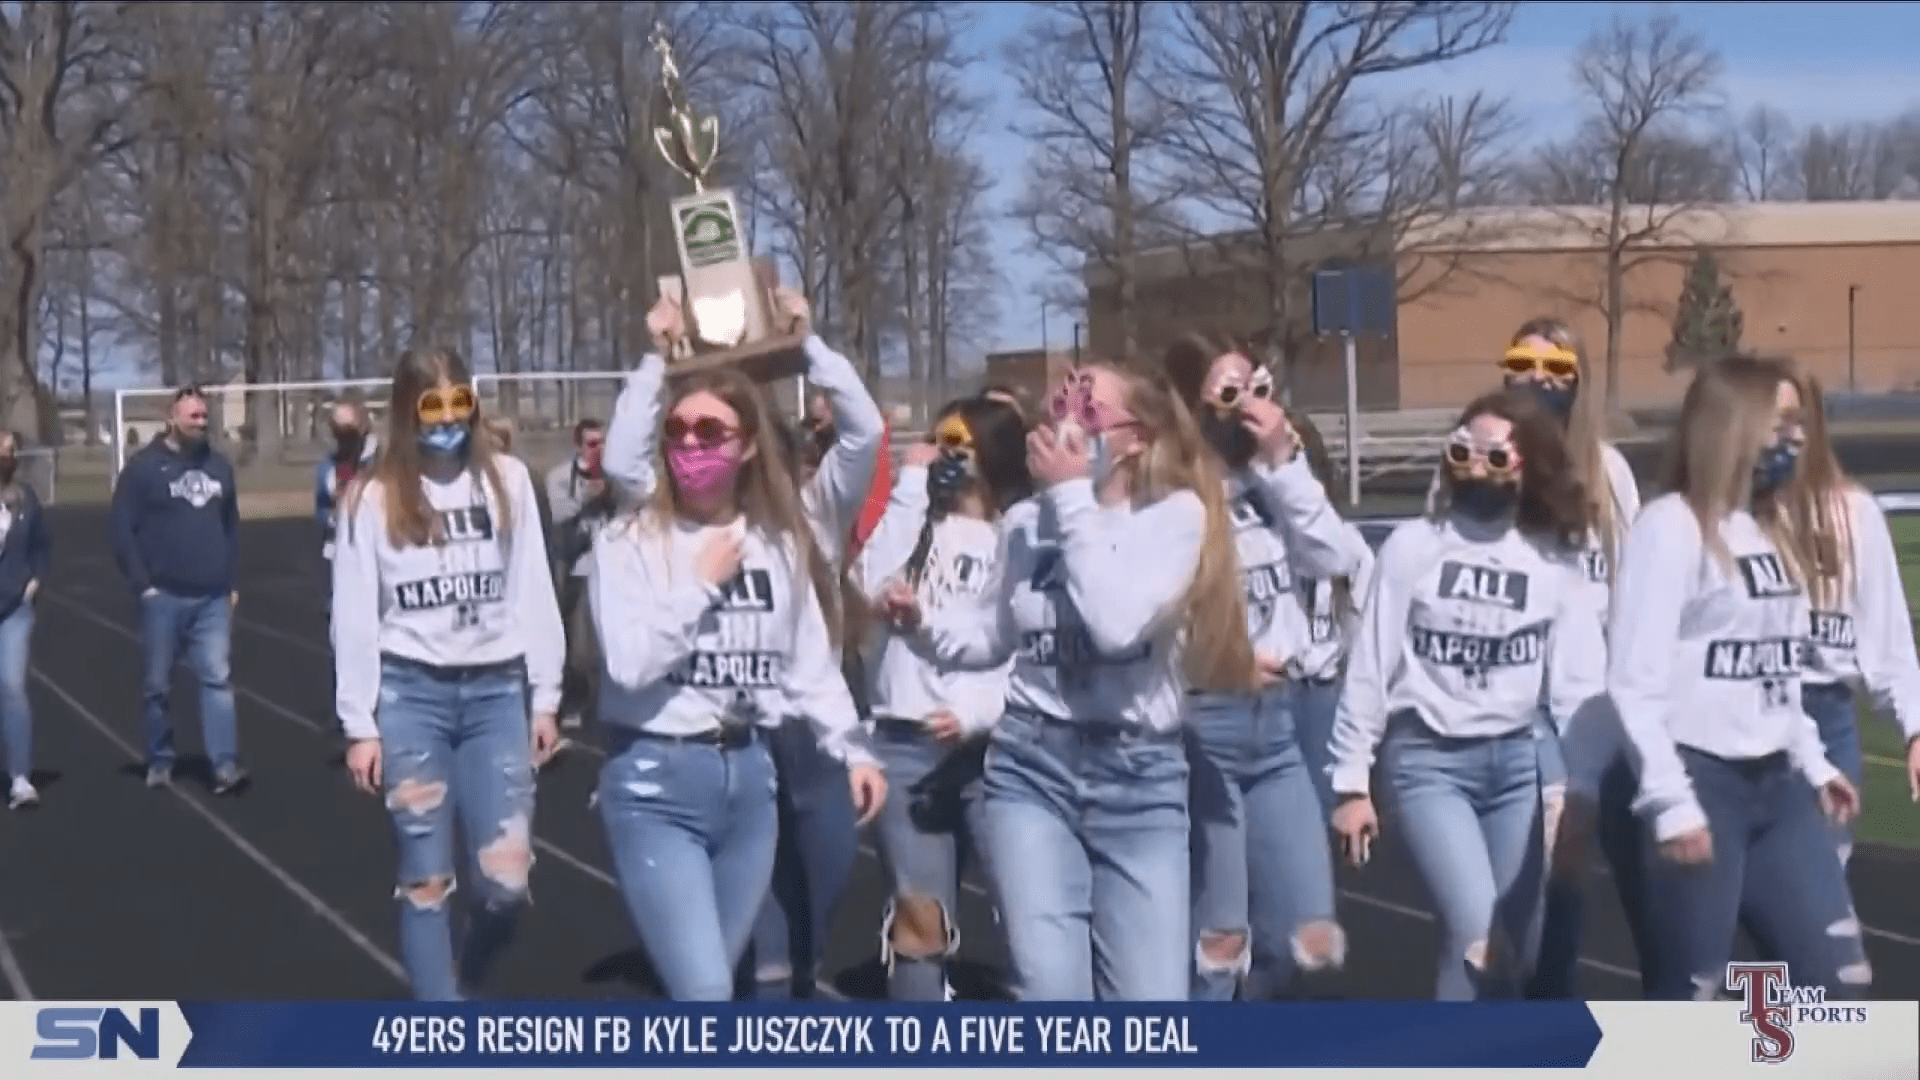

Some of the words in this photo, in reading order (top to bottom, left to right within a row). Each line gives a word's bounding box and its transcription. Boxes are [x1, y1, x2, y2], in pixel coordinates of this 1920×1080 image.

[400, 573, 504, 608] NAPOLEO
[1451, 566, 1515, 605] ALL
[1712, 640, 1805, 678] NAPOLE
